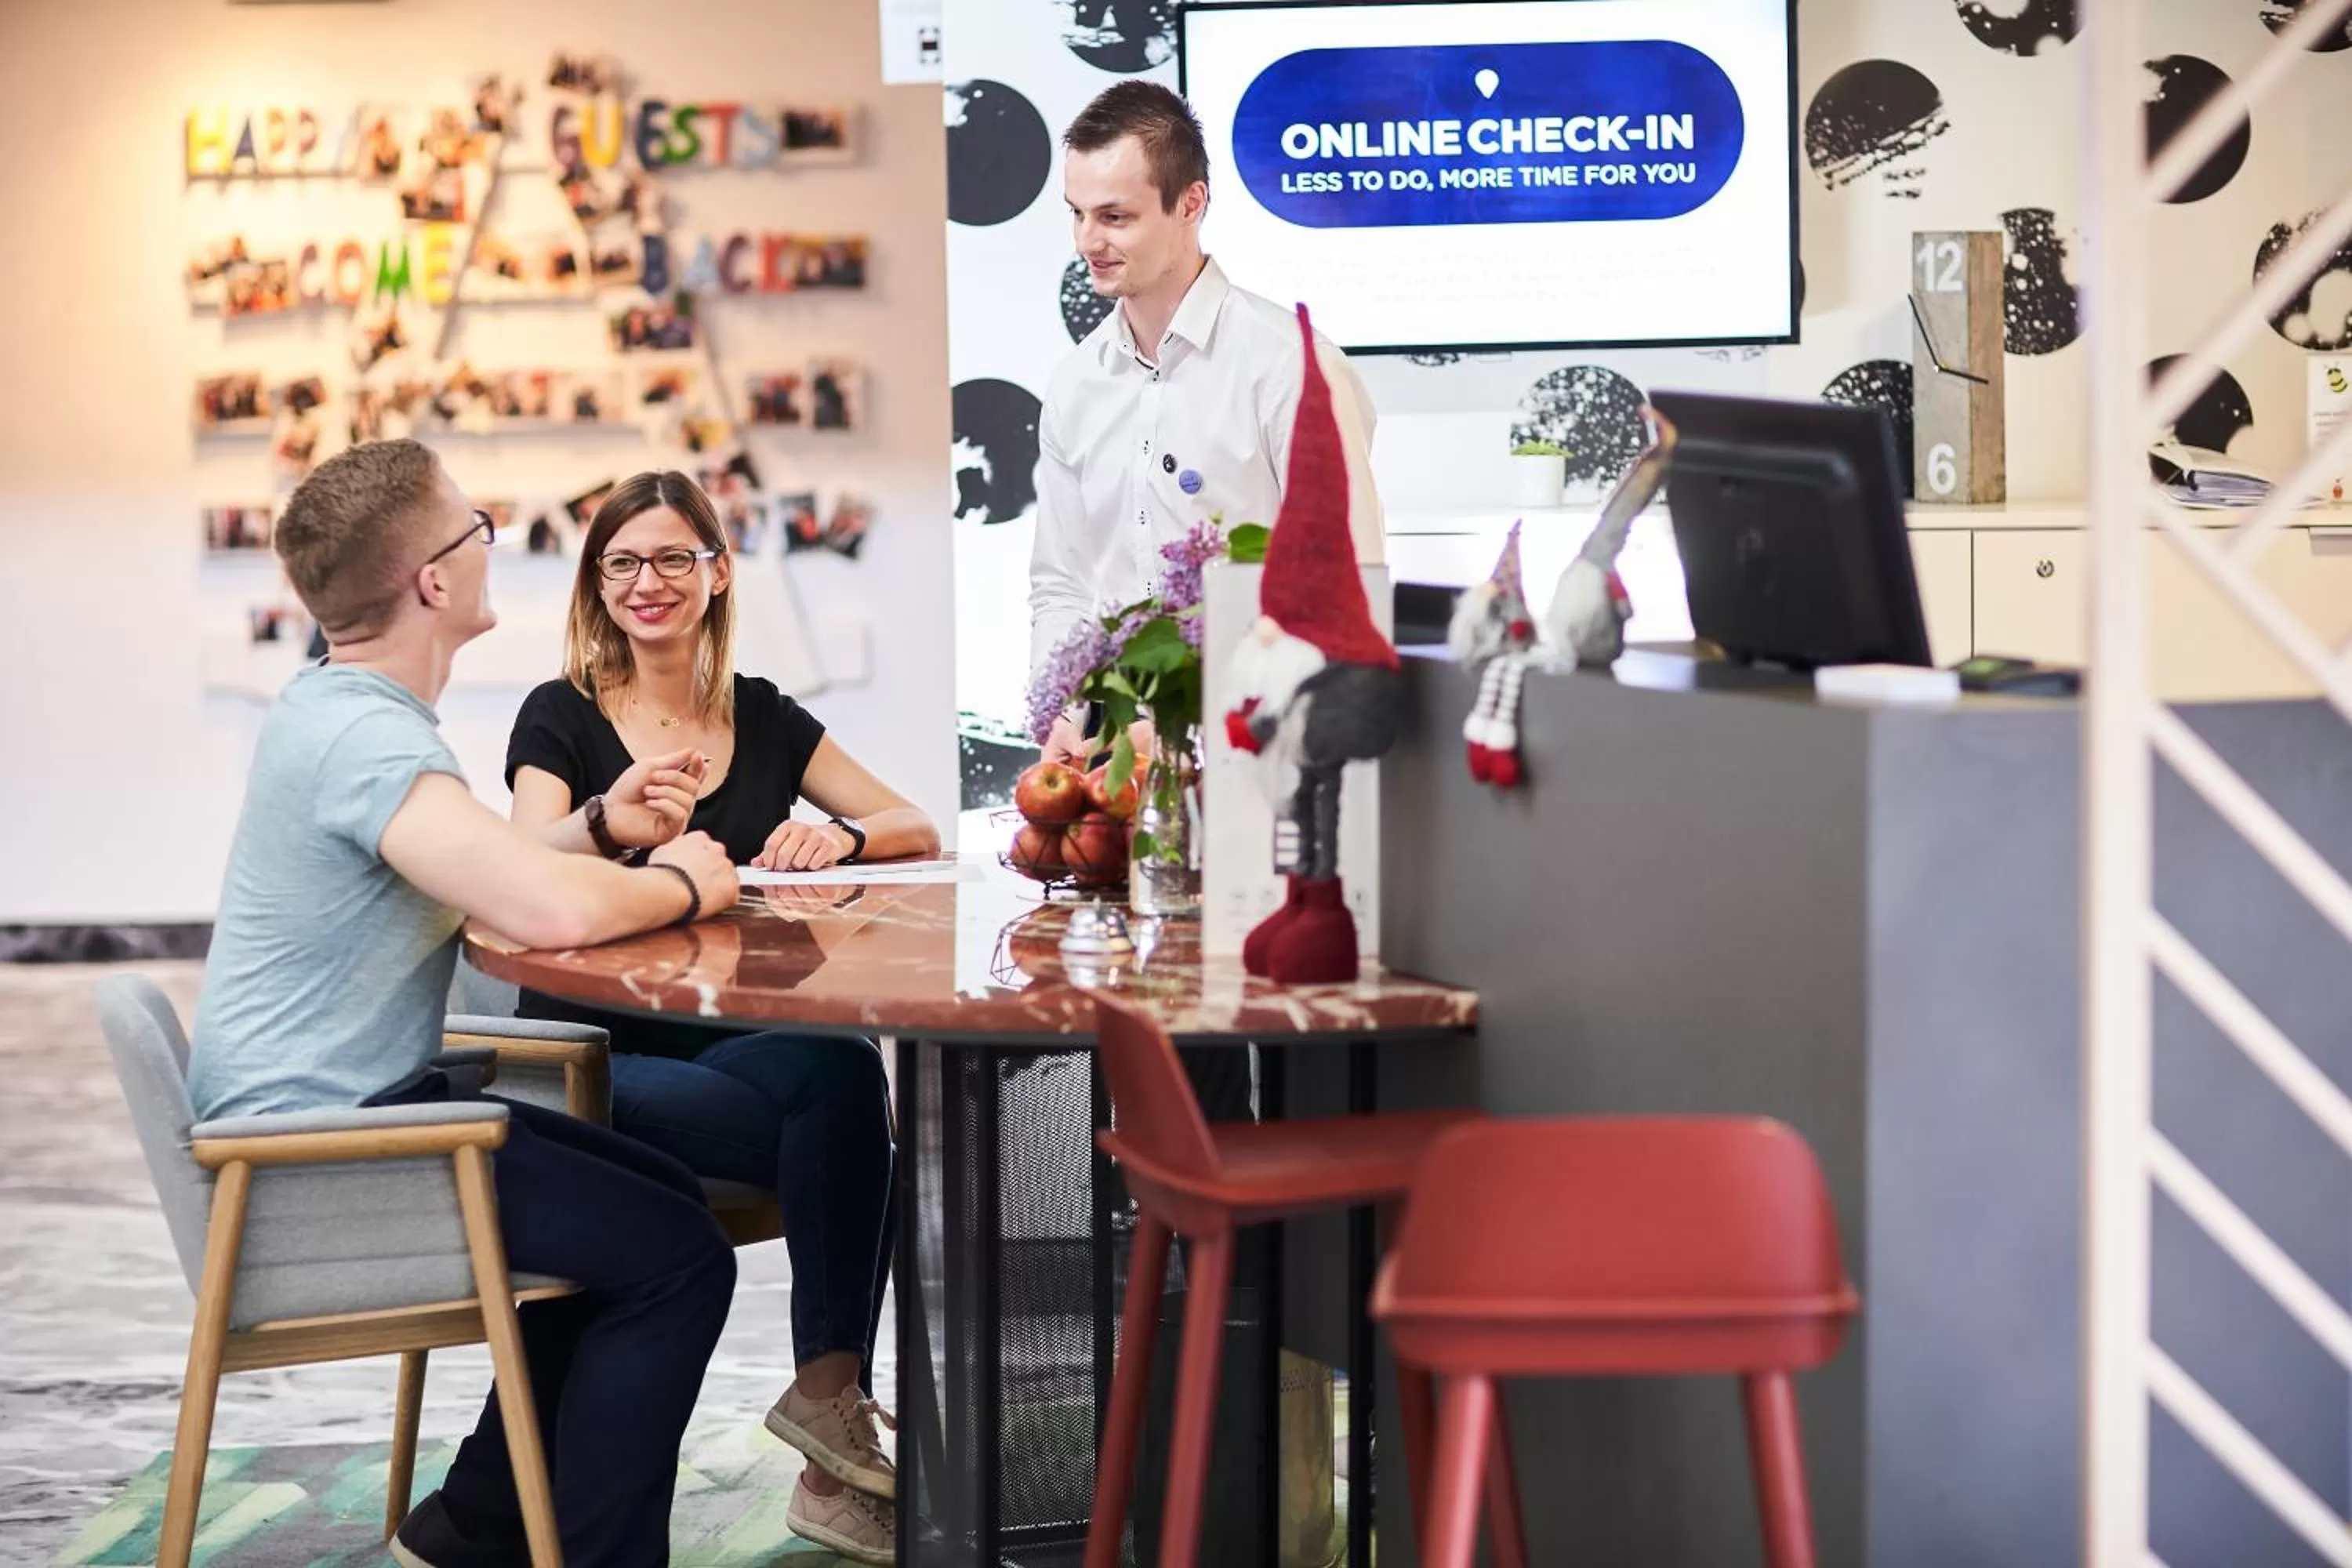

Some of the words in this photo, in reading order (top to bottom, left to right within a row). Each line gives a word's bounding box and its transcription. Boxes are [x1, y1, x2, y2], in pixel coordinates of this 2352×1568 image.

[551, 98, 782, 171] GUESTS
[1281, 120, 1462, 159] ONLINE
[1467, 114, 1694, 154] CHECK-IN
[1282, 170, 1343, 194] LESS
[1348, 170, 1384, 191] TO
[1389, 169, 1434, 191] DO,
[1439, 167, 1513, 189] MORE
[1517, 165, 1578, 187] TIME
[1584, 164, 1637, 185] FOR
[1642, 162, 1696, 184] YOU
[298, 224, 453, 305] COME
[1915, 240, 1963, 293] 12
[1926, 443, 1957, 495] 6
